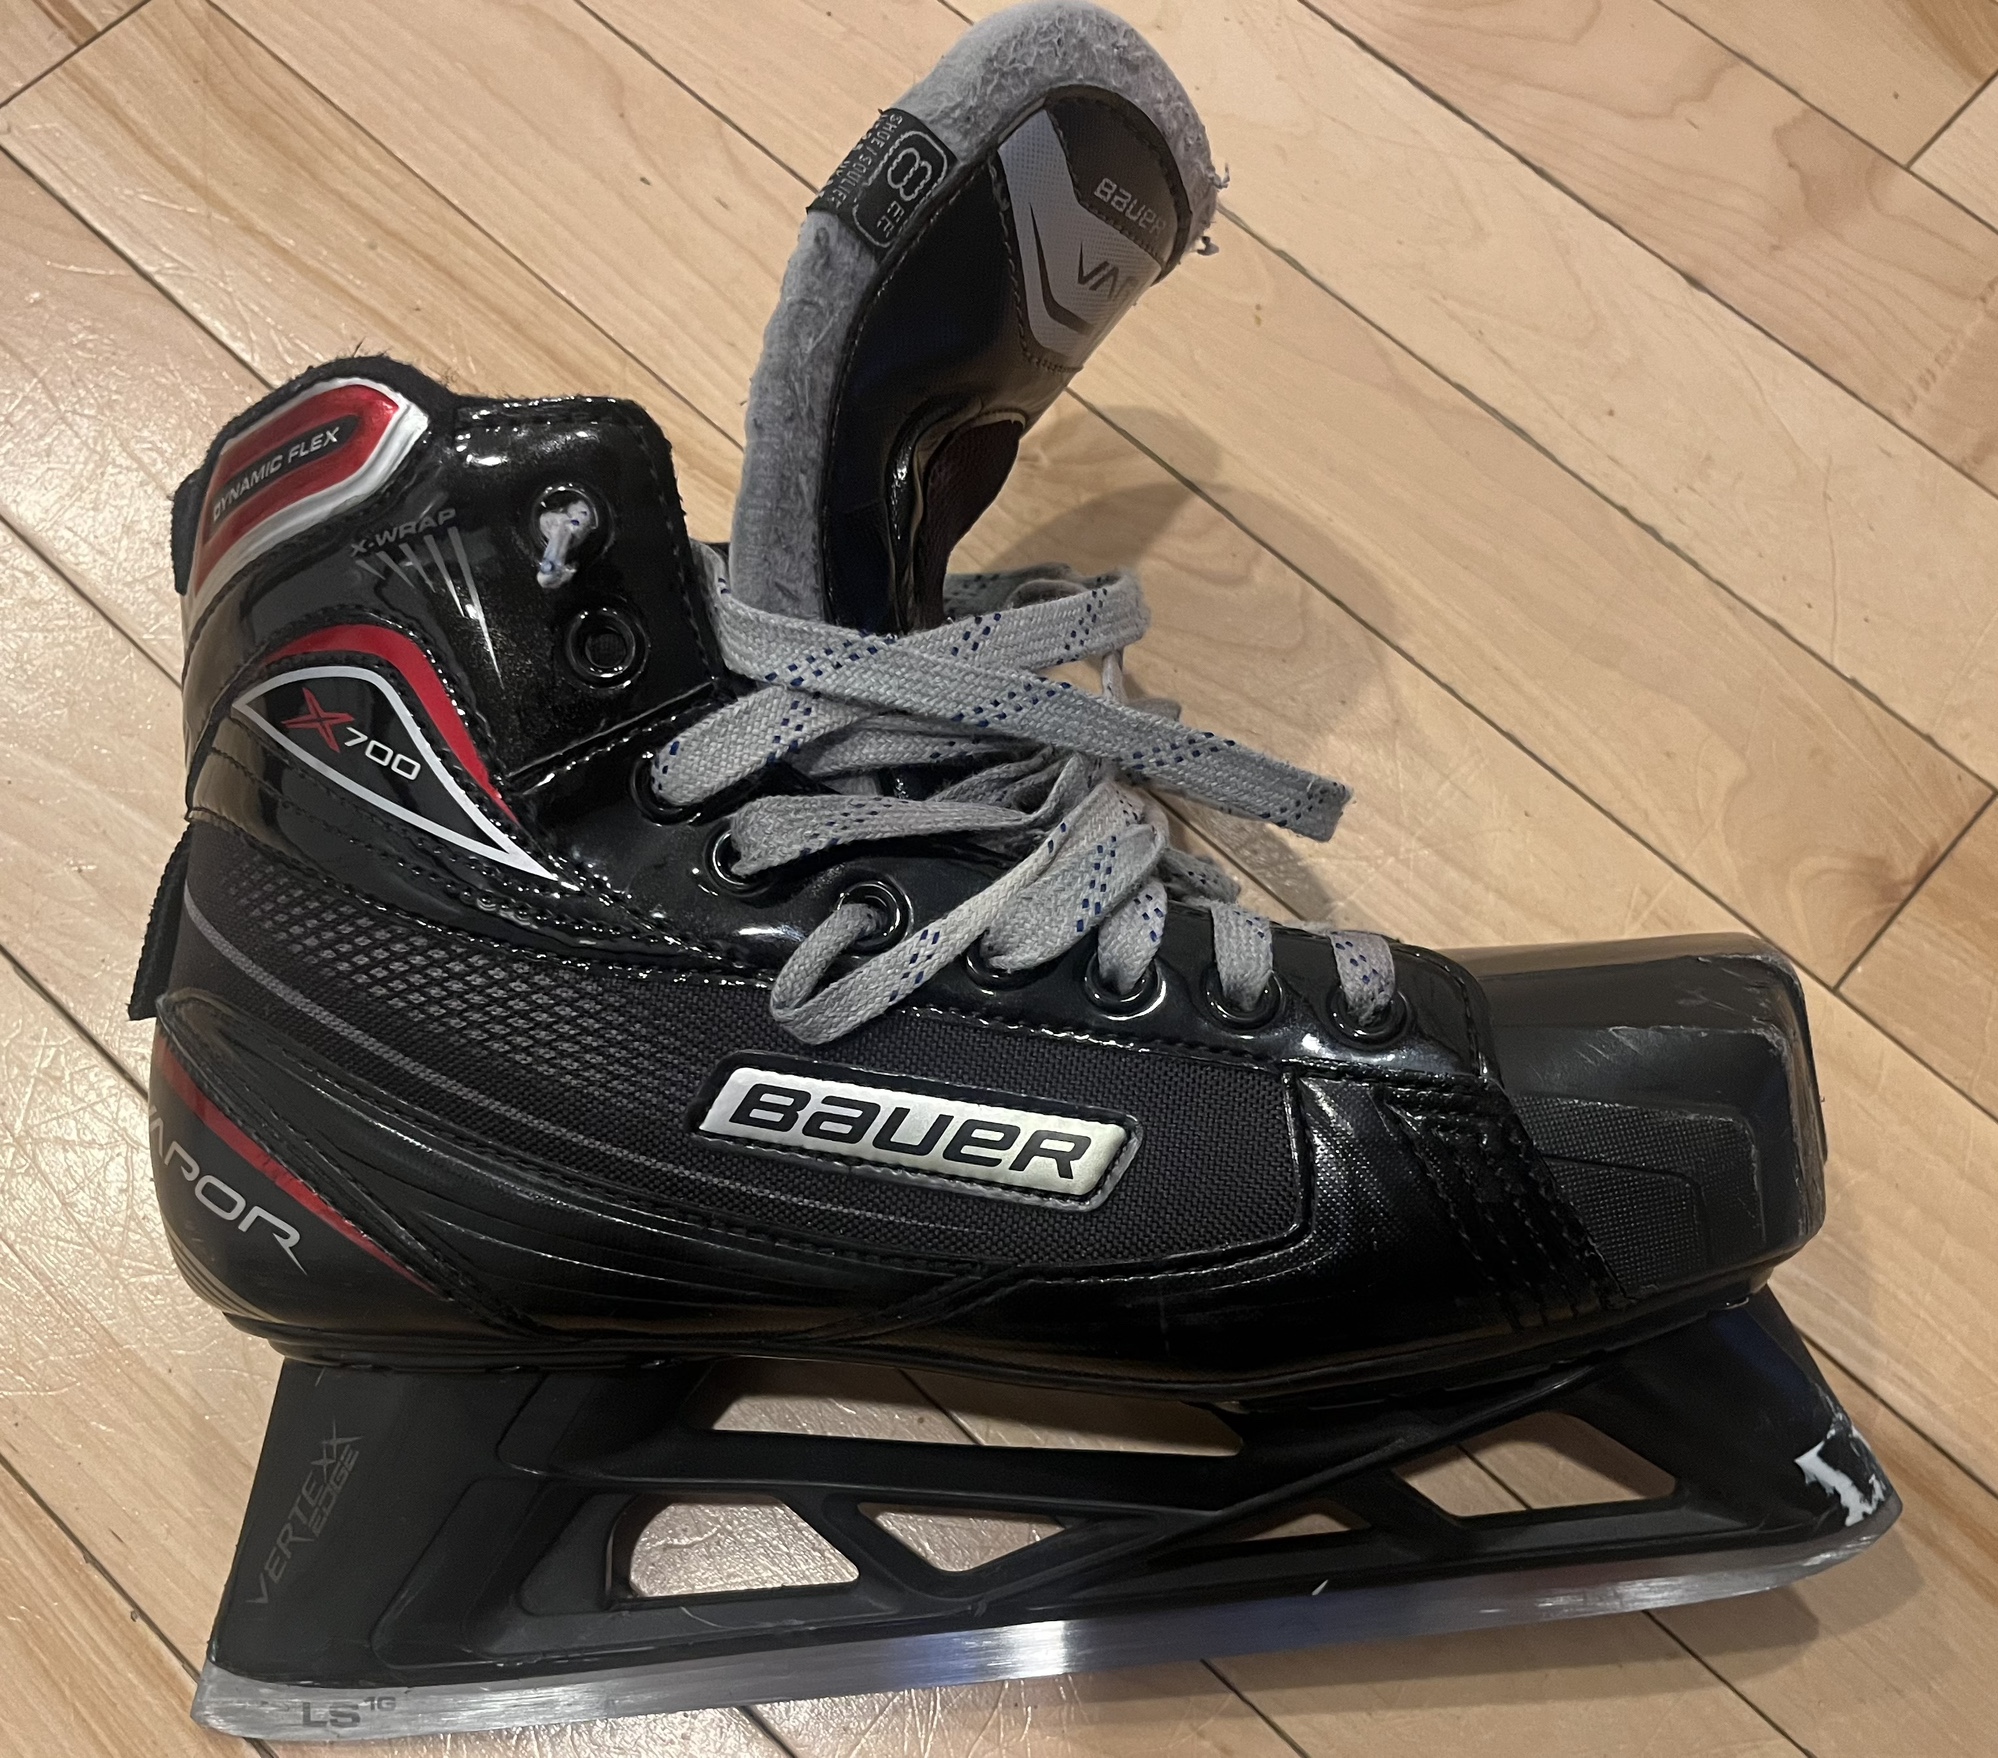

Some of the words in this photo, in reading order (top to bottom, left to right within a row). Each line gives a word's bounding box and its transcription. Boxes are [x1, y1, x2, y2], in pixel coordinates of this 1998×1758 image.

[887, 147, 932, 202] 8
[213, 455, 283, 522] DYNAMIC
[287, 426, 340, 463] FLEX
[350, 508, 456, 558] X-WRAP
